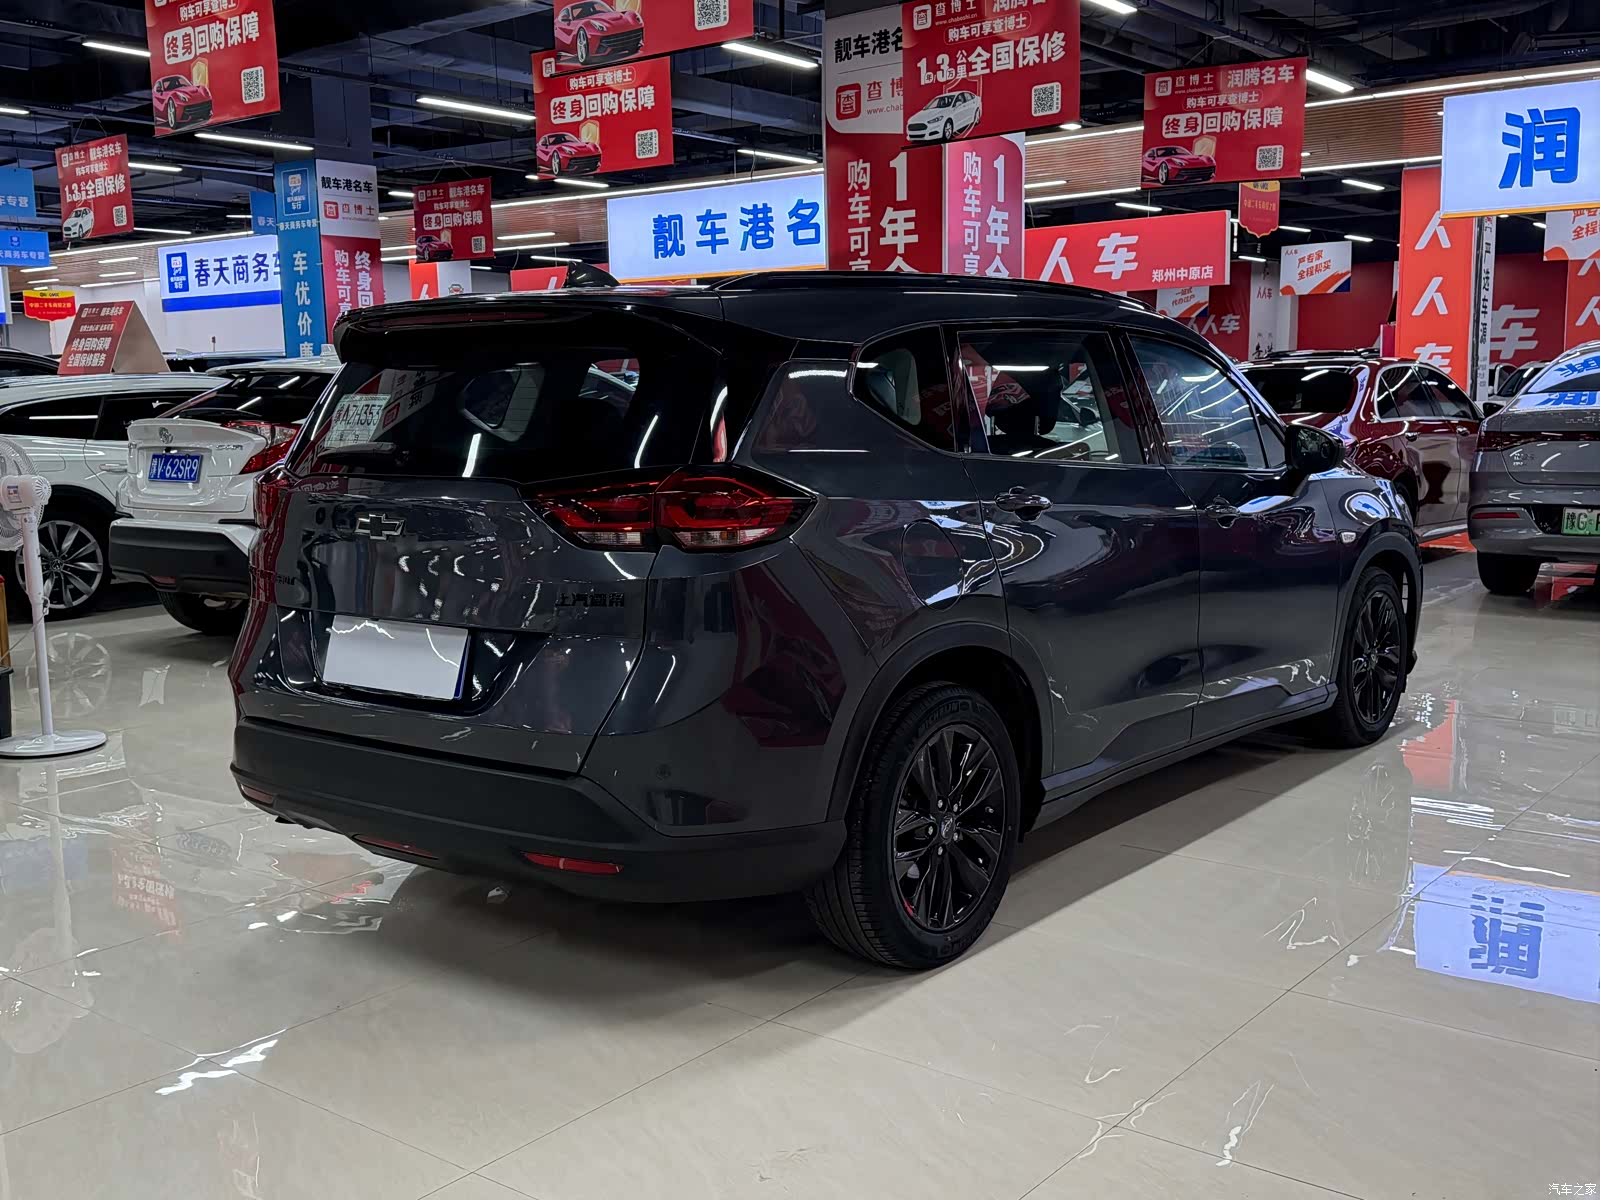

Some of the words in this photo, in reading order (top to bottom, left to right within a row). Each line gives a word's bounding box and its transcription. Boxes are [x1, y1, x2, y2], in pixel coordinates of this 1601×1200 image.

[166, 11, 260, 59] 终身回购保障
[948, 14, 1027, 42] 购车可享查博士
[834, 27, 903, 63] 靓车港名
[569, 69, 633, 91] 购车可享查博士
[1227, 64, 1295, 88] 润腾名车
[552, 85, 655, 120] 终身回购保障
[1186, 91, 1259, 109] 购车可享查博士
[1165, 106, 1283, 135] 终身回购保障
[1498, 107, 1581, 189] 润
[321, 176, 373, 193] 靓车港名车
[425, 210, 483, 228] 终身回购保障
[652, 199, 822, 259] 靓车港名
[1152, 265, 1213, 283] 郑州中原店
